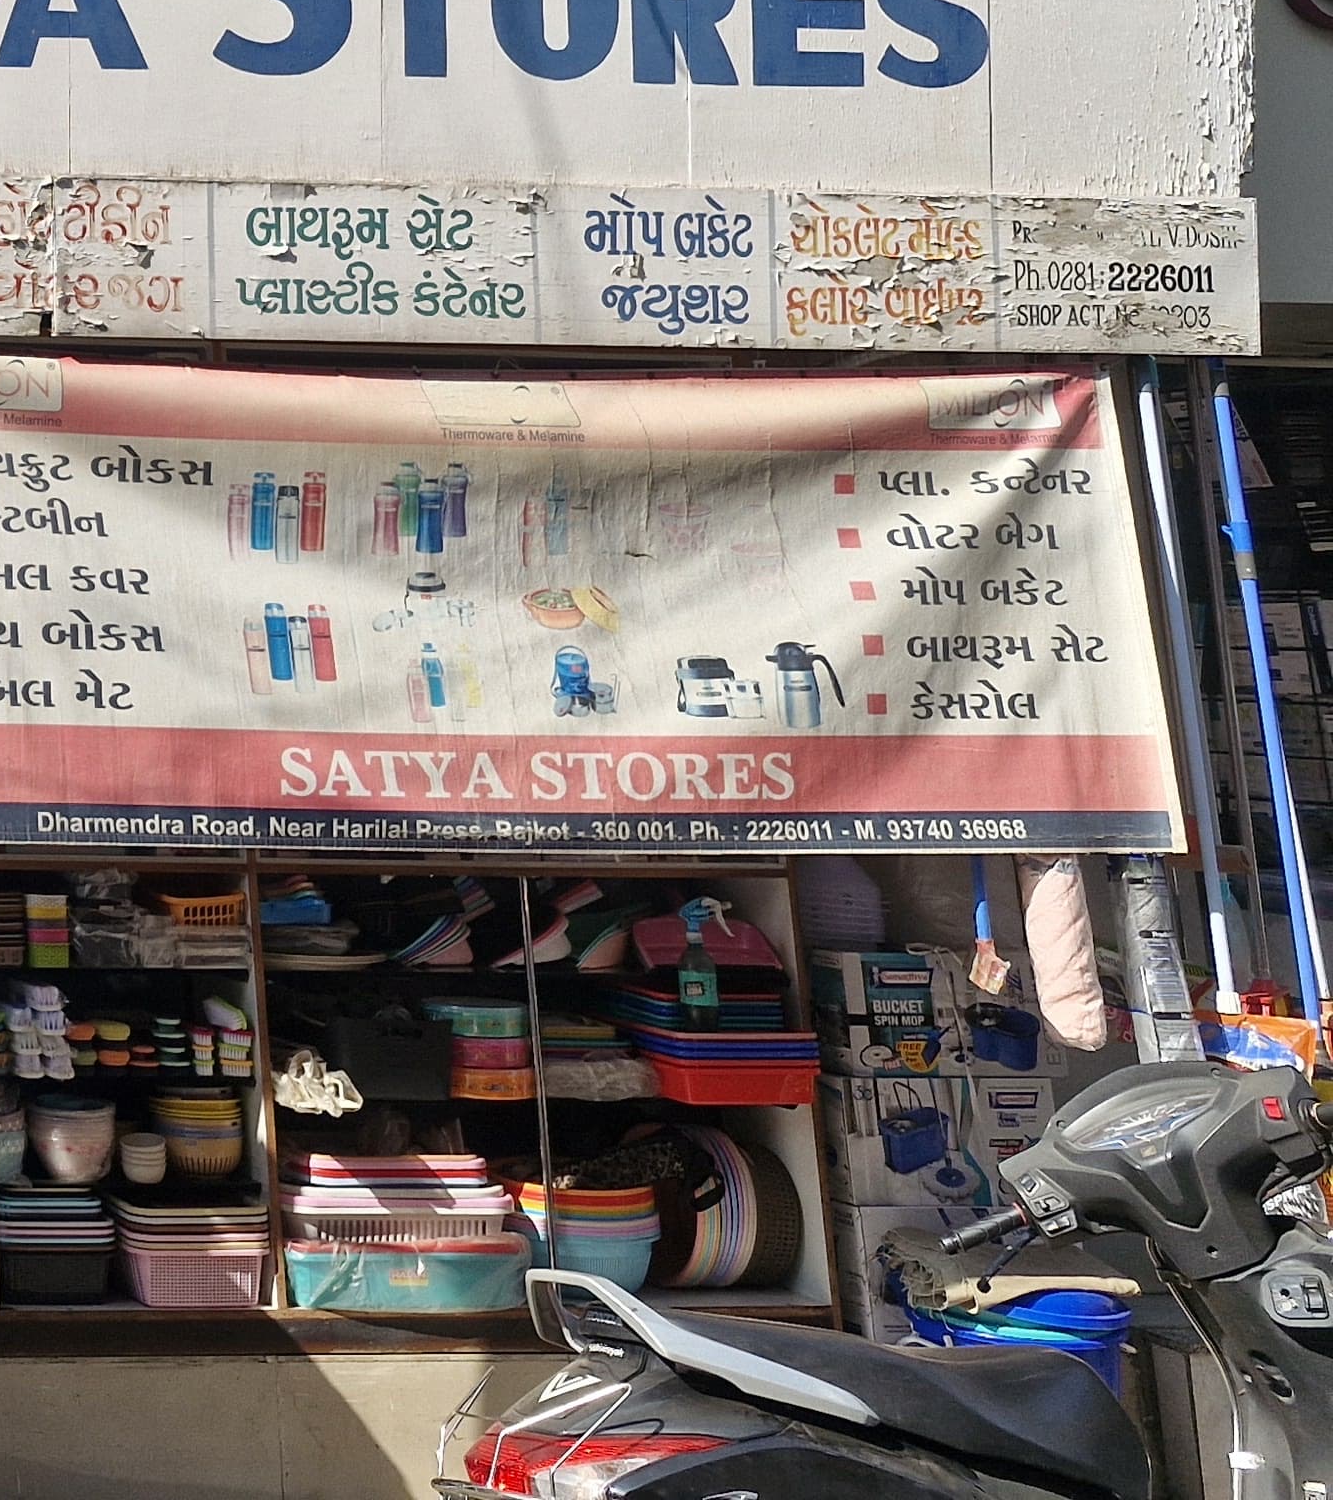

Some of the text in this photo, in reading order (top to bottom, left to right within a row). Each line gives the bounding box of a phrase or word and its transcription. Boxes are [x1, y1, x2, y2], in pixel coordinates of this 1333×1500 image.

[245, 193, 475, 261] બાથરૂમ સેટ
[583, 192, 754, 259] મોપ બકેટ
[1017, 304, 1063, 327] SHOP
[3, 411, 63, 430] Melamine
[936, 382, 1045, 422] MILTON
[441, 427, 586, 444] Thermoware & Melamine
[931, 431, 997, 447] Thermoware
[90, 444, 214, 487] બોકસ
[886, 512, 1061, 552] વોટર બેગ
[70, 563, 151, 597] કવર
[901, 567, 1069, 608] મોપ બકેટ
[41, 609, 166, 652] બોકસ
[906, 625, 1109, 673] બાથરૂમ સેટ
[74, 668, 134, 711] મેટ
[910, 679, 1040, 722] કેસરોલ
[279, 747, 796, 802] SATYA STORES
[36, 810, 185, 838] Dharmendra
[191, 814, 262, 840] Road,
[269, 816, 324, 839] Near
[331, 817, 408, 841] Harilal
[497, 820, 571, 846] Rajkot
[593, 821, 632, 842] 360
[638, 821, 683, 842] 001.
[690, 820, 727, 842] Ph.
[745, 820, 834, 842] 2226011
[855, 819, 883, 842] M.
[887, 819, 955, 841] 93740
[961, 819, 1027, 841] 36968
[872, 999, 925, 1015] BUCKET
[873, 1014, 925, 1027] SPIN MOP
